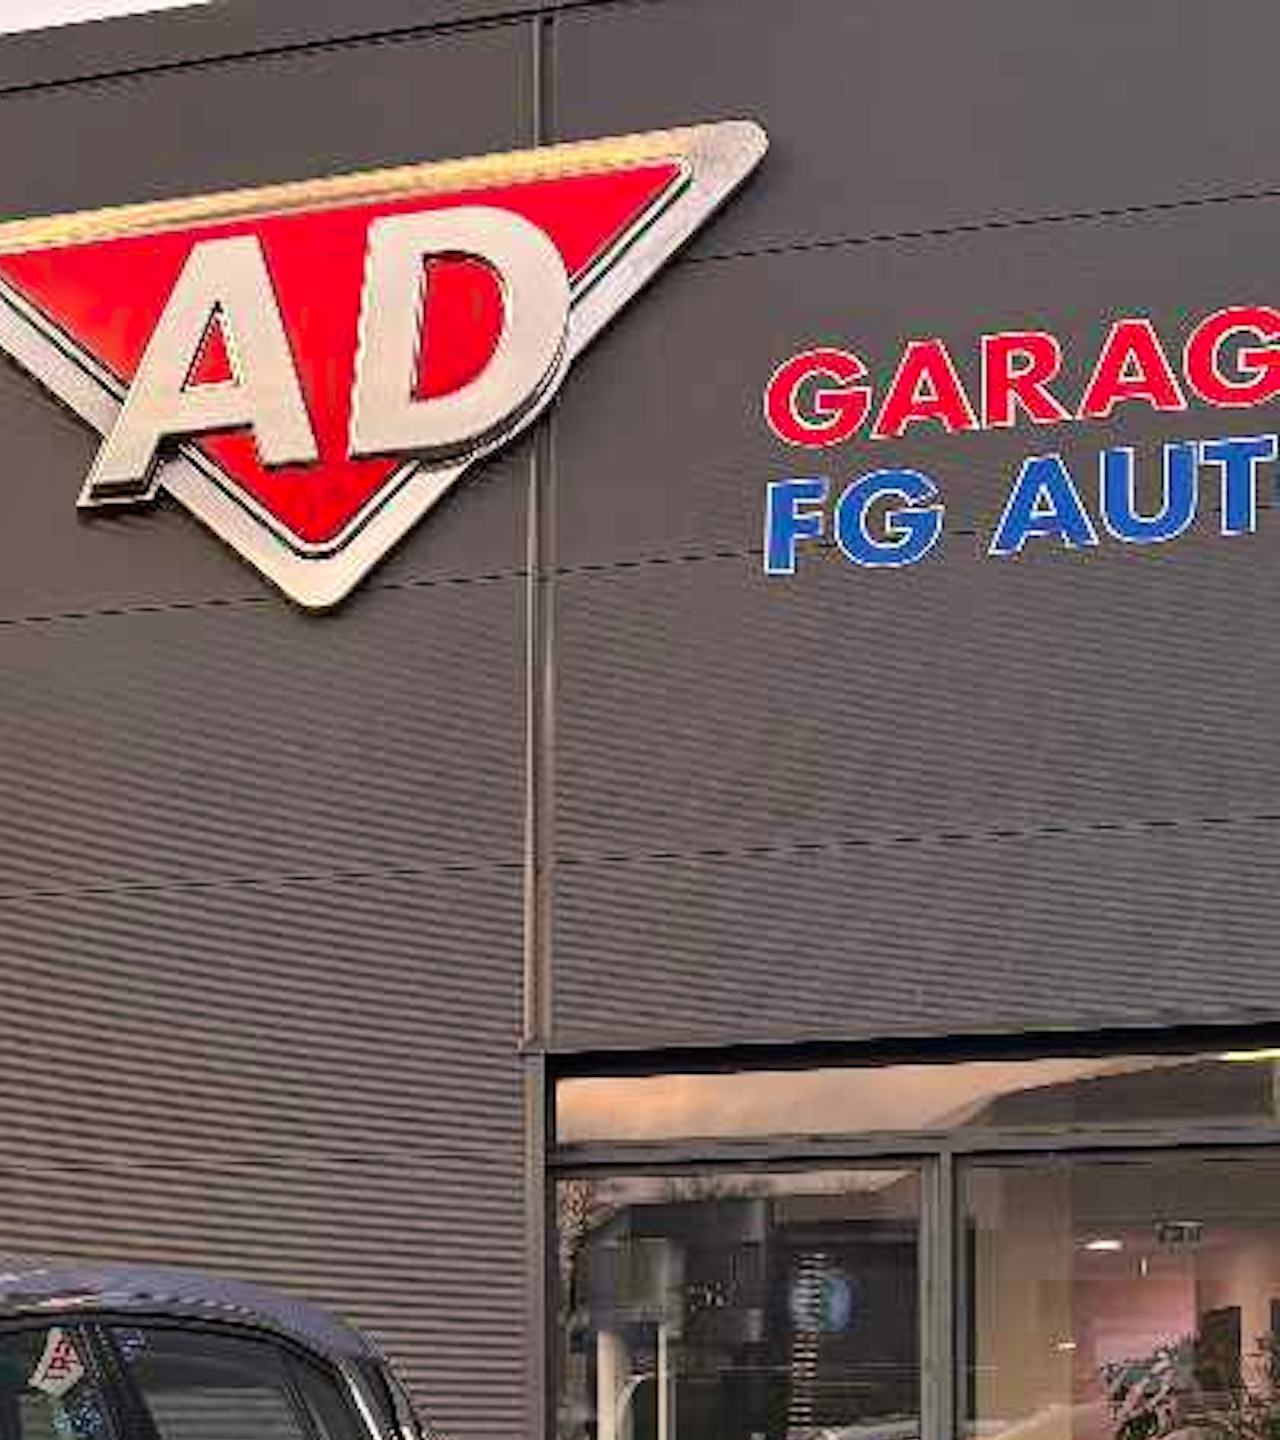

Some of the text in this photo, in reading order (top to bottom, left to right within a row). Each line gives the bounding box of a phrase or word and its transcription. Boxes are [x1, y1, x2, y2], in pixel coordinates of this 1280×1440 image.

[77, 204, 570, 507] AD
[763, 305, 1280, 449] GARAG
[763, 433, 1279, 574] FG AUT
